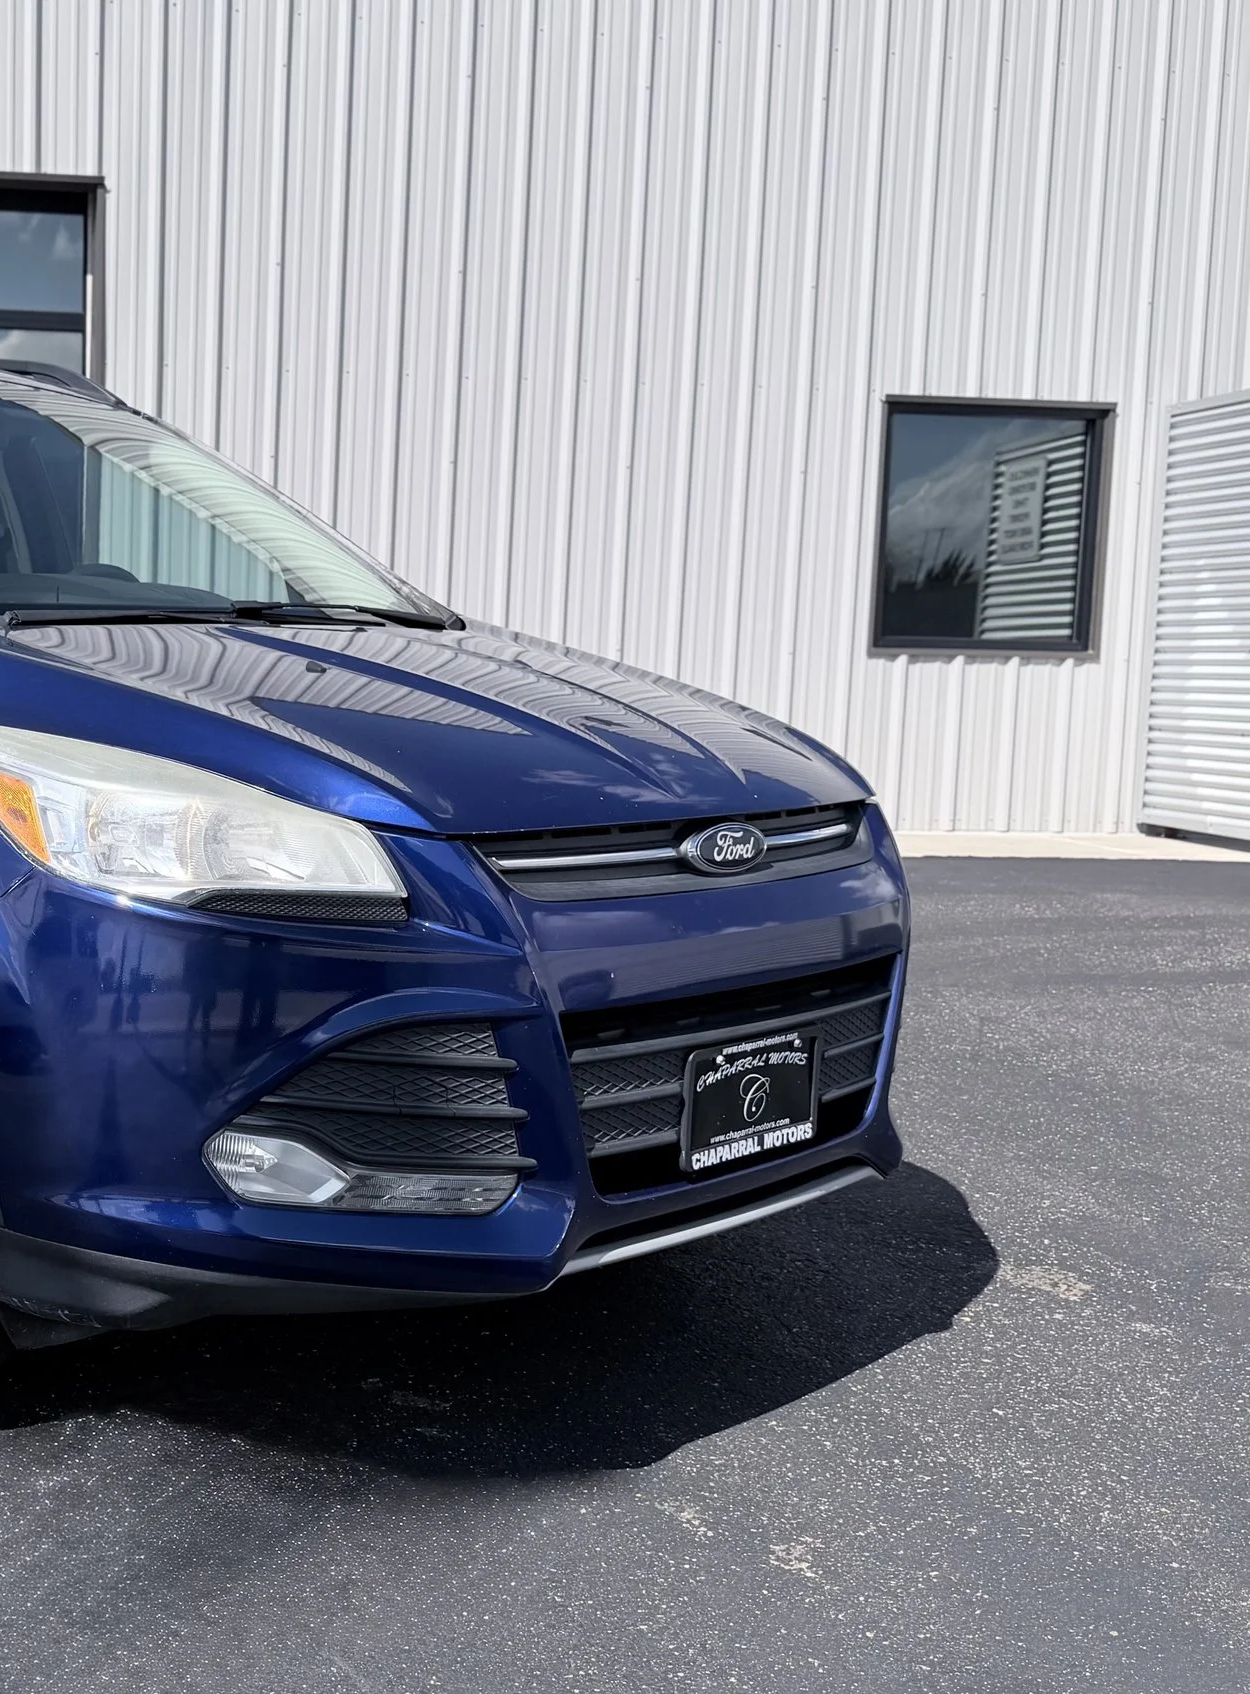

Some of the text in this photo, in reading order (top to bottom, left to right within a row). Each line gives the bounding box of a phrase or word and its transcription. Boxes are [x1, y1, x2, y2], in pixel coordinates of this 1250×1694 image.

[713, 831, 755, 862] Ford
[722, 1032, 799, 1056] www.chaparral-motors.com
[696, 1051, 808, 1092] CHAPARRAL MOTORS
[691, 1122, 813, 1170] CHAPARRAL MOTORS
[710, 1118, 790, 1144] www.chaparral-motors.com
